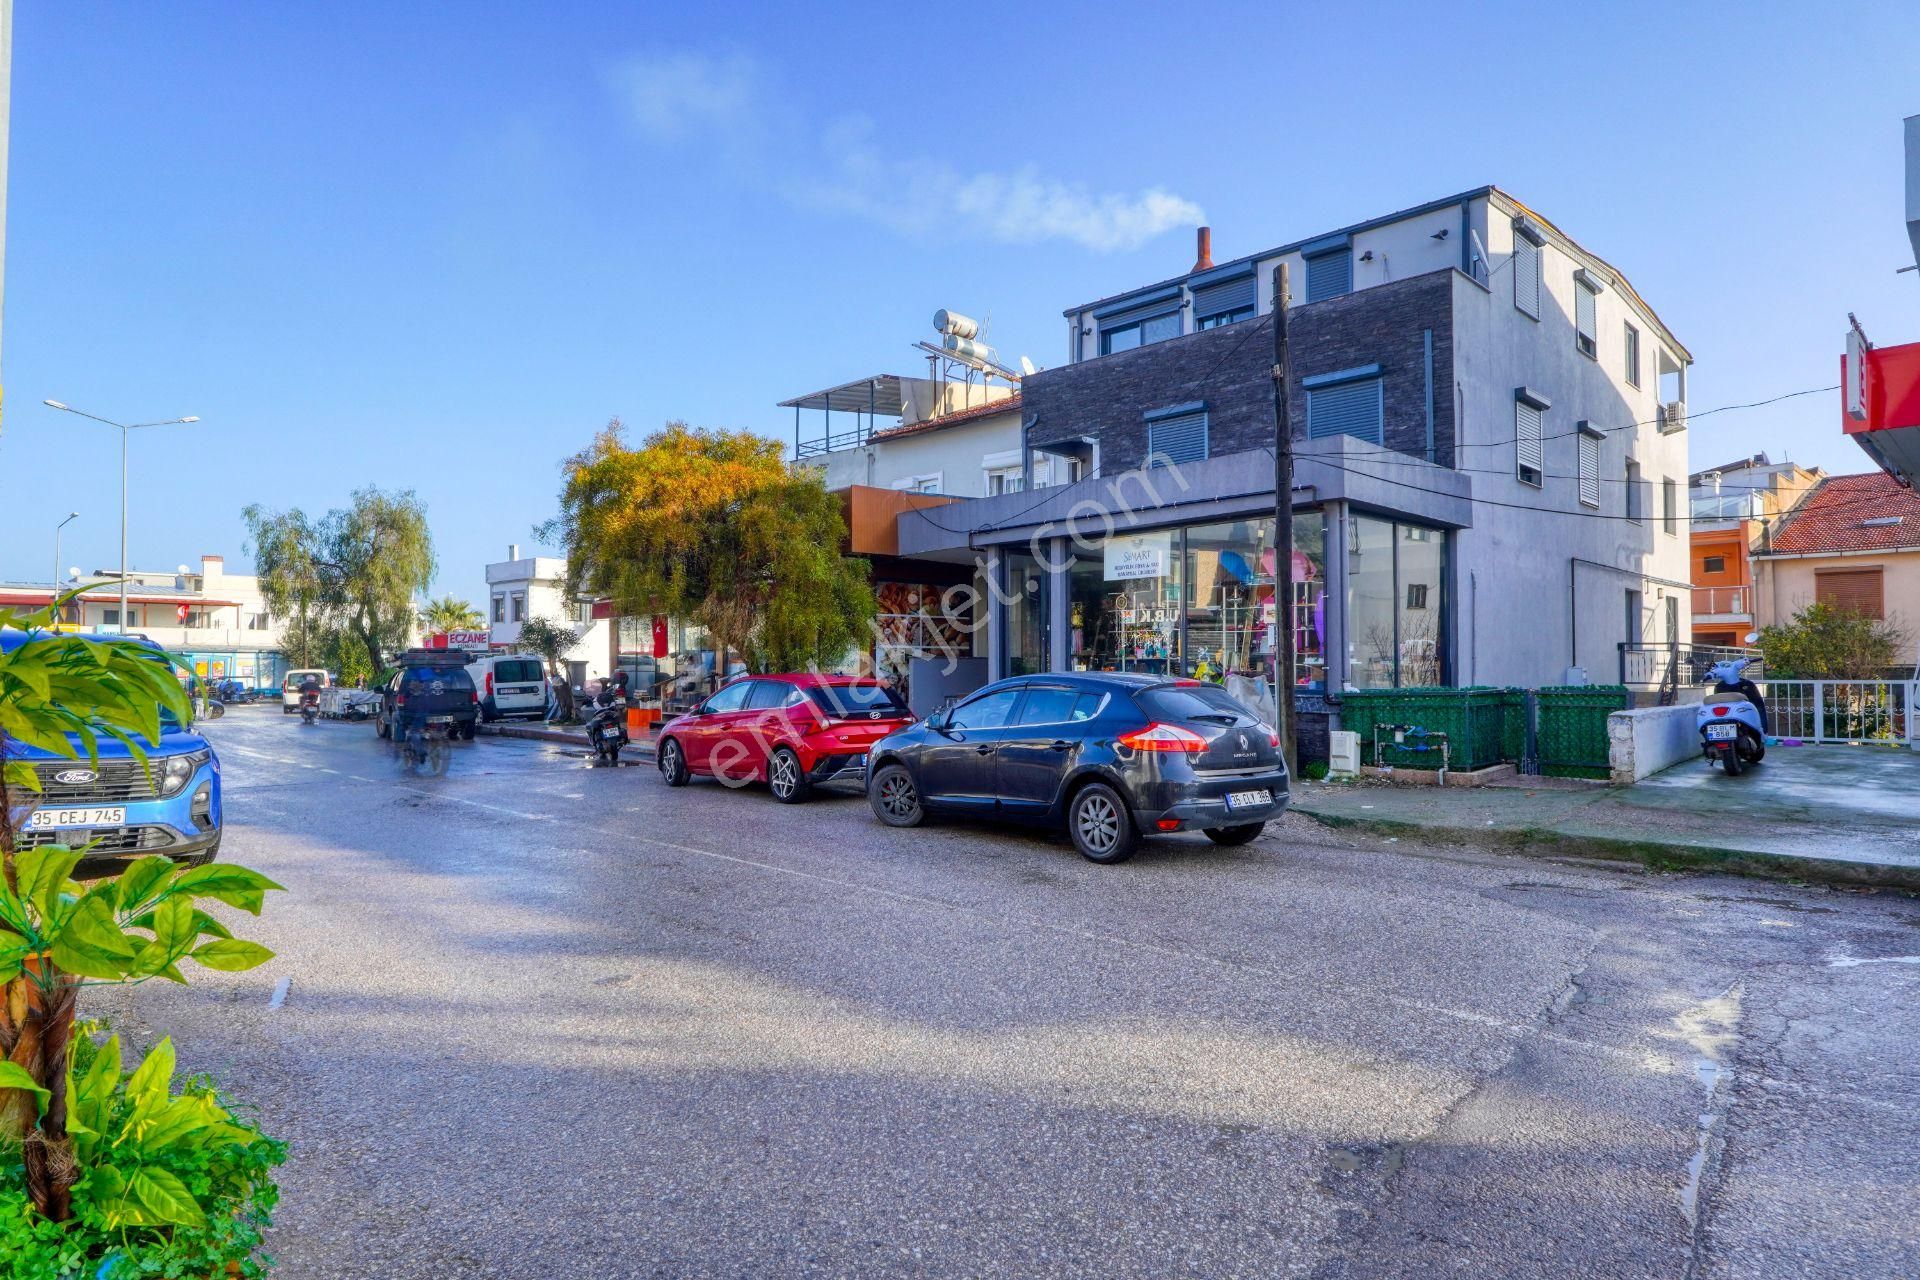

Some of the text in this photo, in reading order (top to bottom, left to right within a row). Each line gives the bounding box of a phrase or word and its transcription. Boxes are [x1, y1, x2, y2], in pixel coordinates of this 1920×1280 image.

[450, 633, 487, 643] ECZANE
[63, 771, 90, 781] Ford
[1232, 795, 1242, 806] 35
[33, 809, 121, 825] 35 CEJ 745
